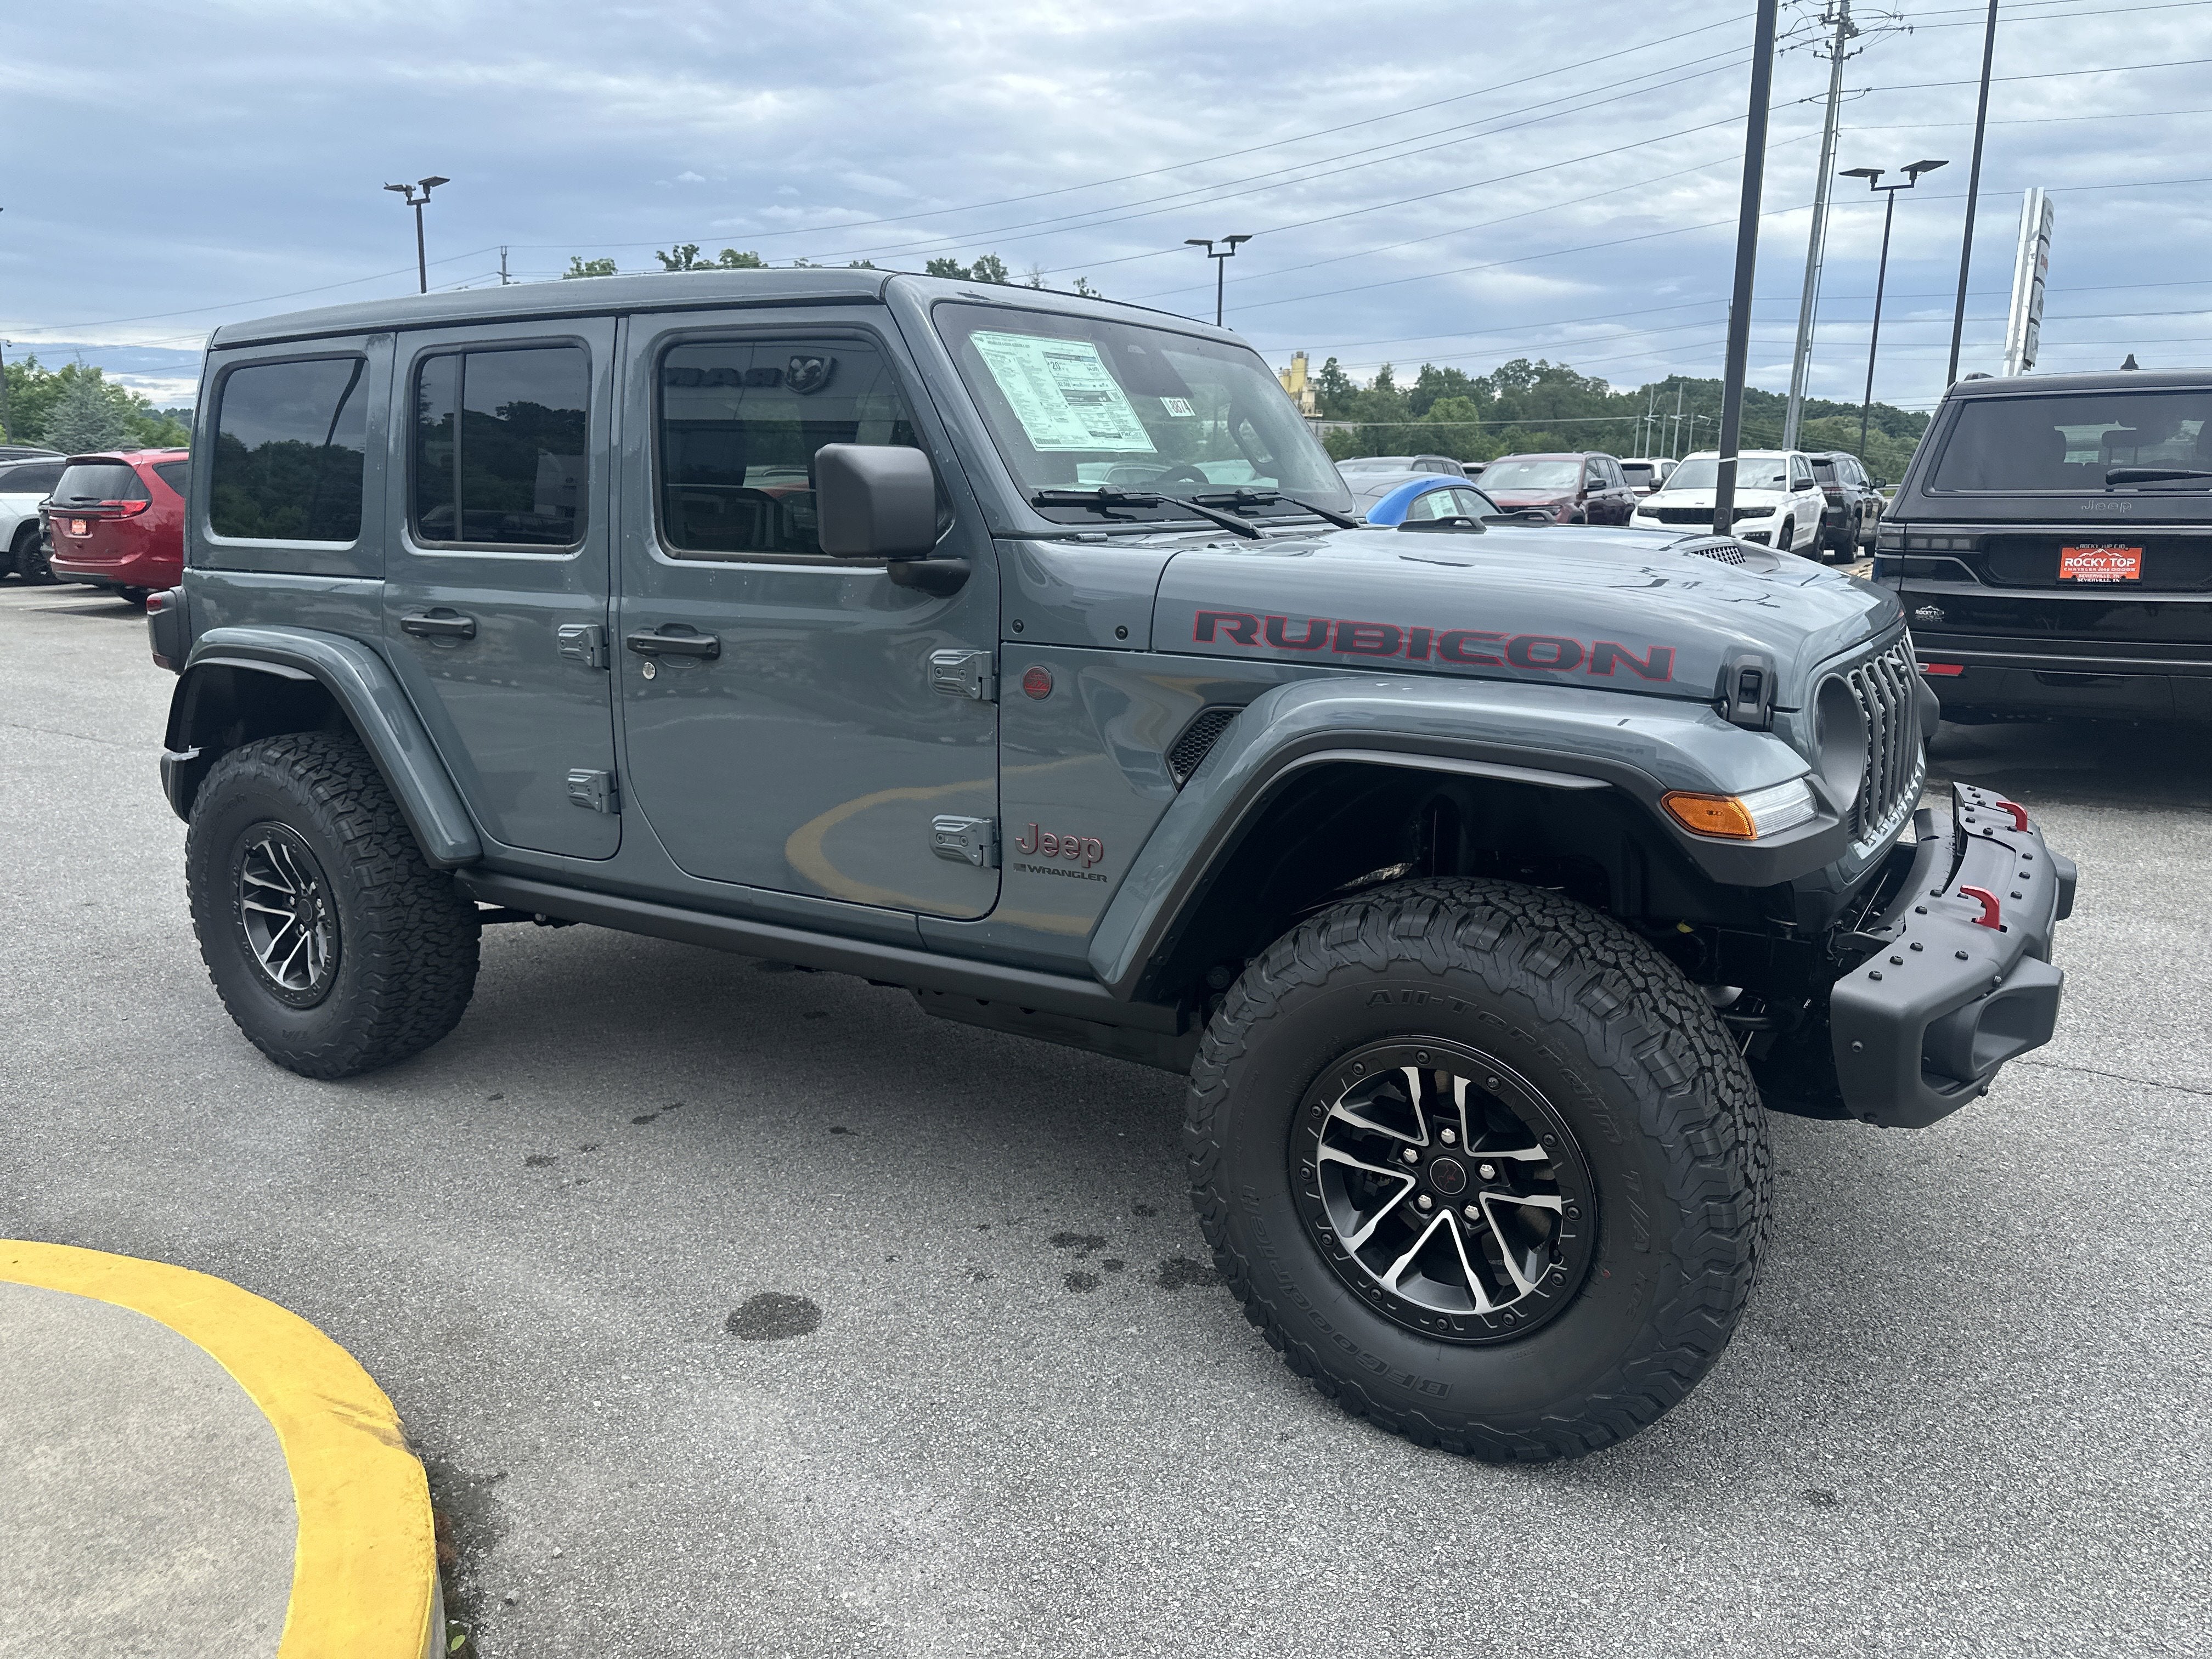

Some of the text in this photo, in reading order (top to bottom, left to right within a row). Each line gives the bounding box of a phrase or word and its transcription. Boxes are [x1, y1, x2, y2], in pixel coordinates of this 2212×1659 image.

[1050, 362, 1061, 370] 20
[1169, 399, 1191, 414] 8874
[2081, 500, 2131, 513] Jeep
[2064, 557, 2136, 567] ROCKY TOP
[1193, 610, 1676, 682] RUBICON
[1015, 822, 1104, 868] Jeep
[1027, 864, 1108, 883] WRANGLER
[1364, 989, 1625, 1146] All-Terrain
[1621, 1170, 1651, 1254] T/A
[1241, 1184, 1454, 1400] BFGoodrich
